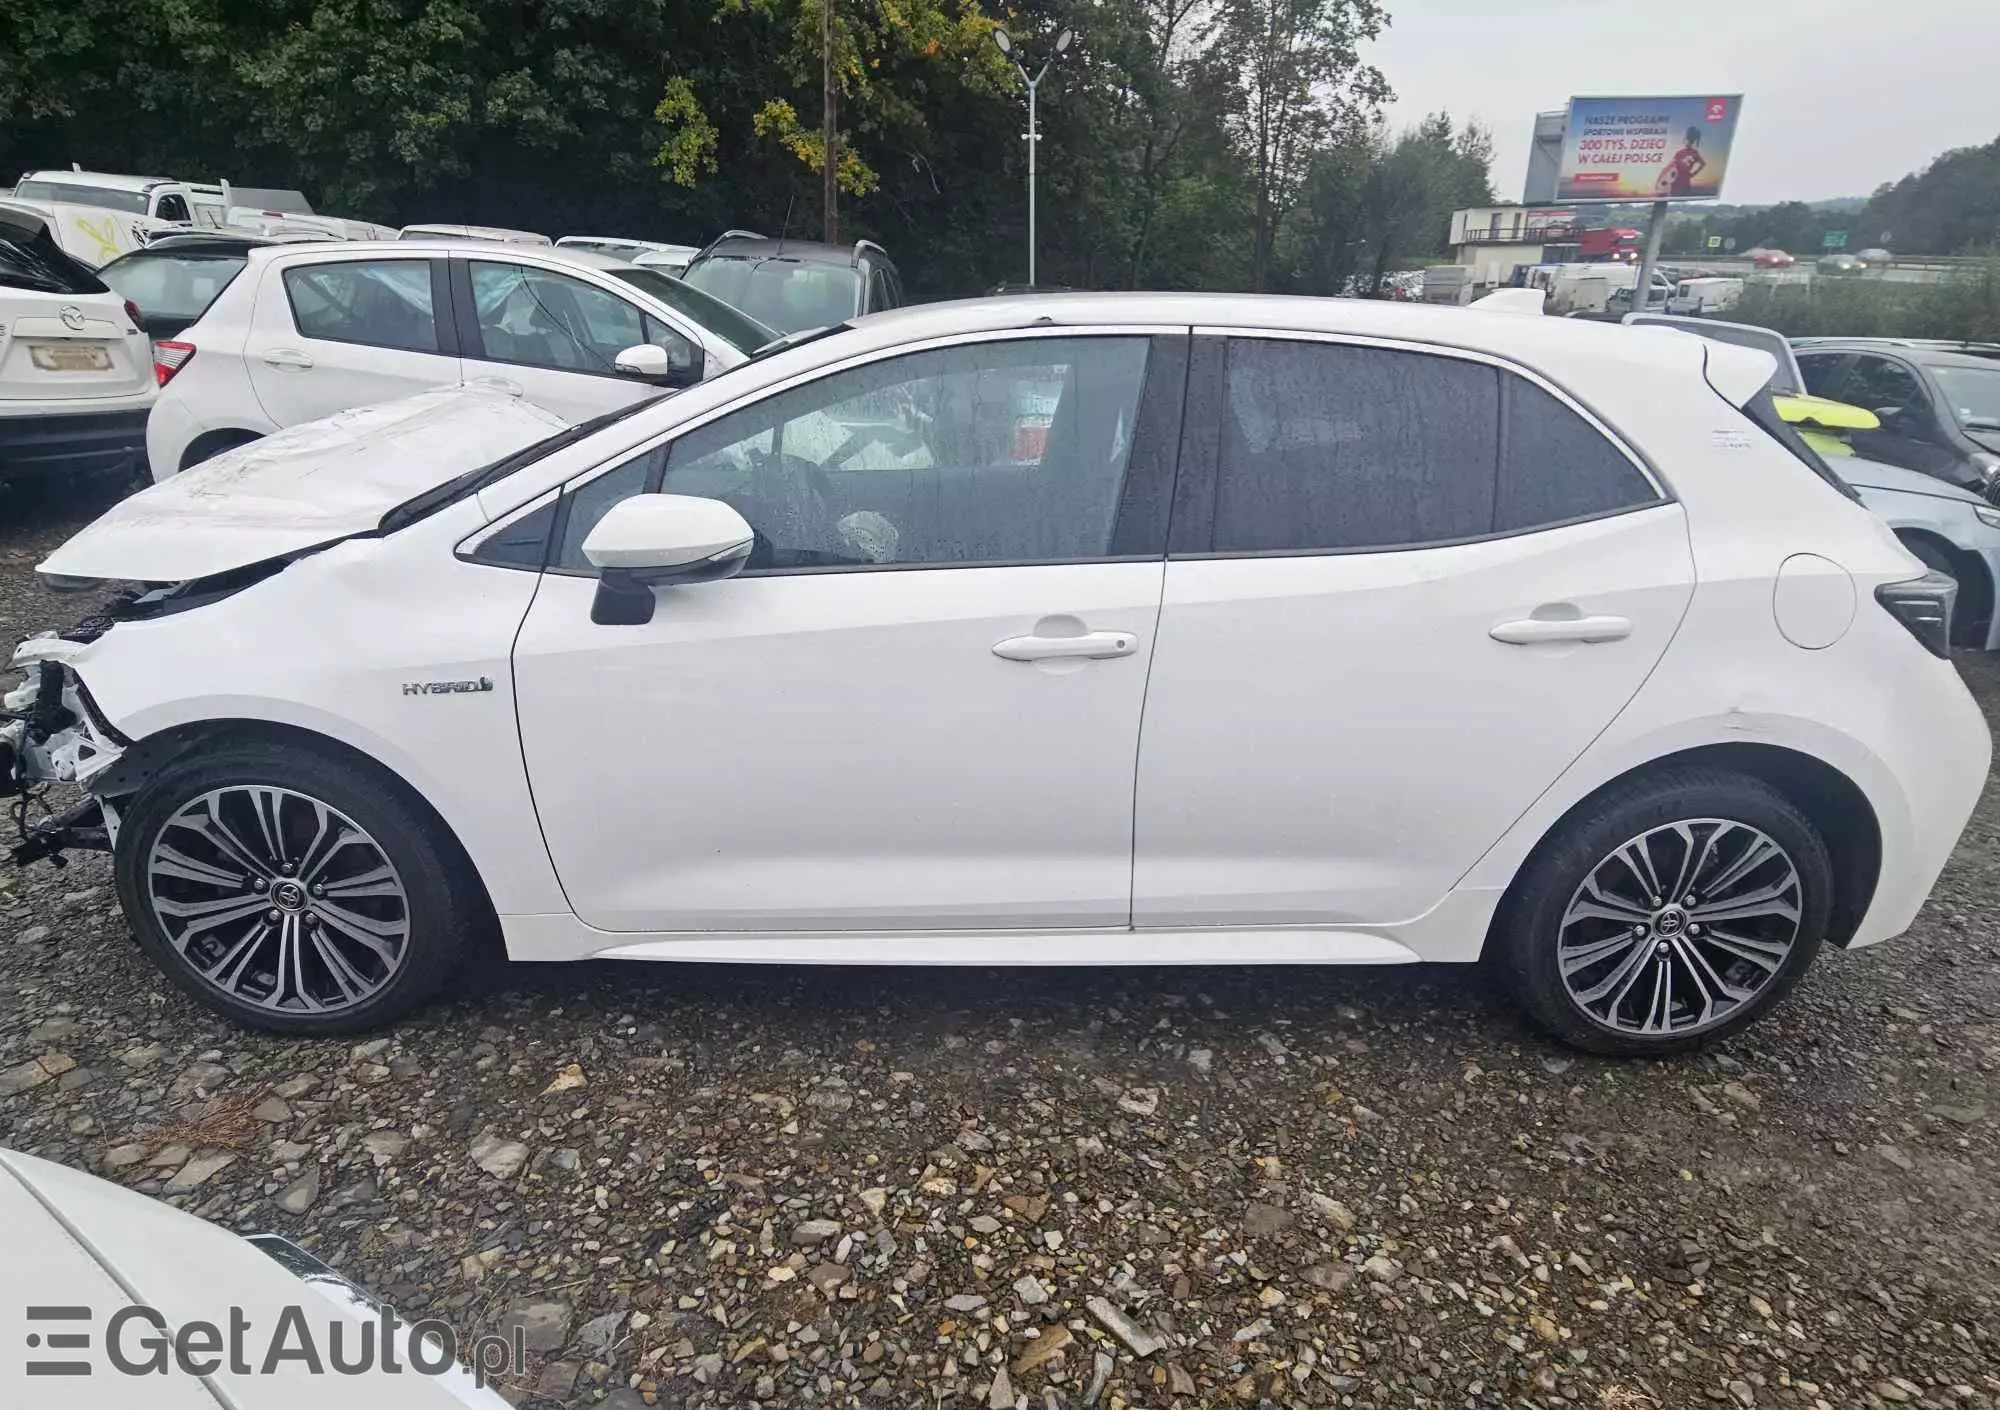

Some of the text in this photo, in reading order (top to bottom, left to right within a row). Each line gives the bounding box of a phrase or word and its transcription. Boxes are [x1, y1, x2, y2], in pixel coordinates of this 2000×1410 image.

[1579, 138, 1666, 150] 300 TYS. DZIECI
[1577, 153, 1590, 164] W
[1623, 152, 1664, 163] POLSCE
[401, 681, 480, 696] HYBRID
